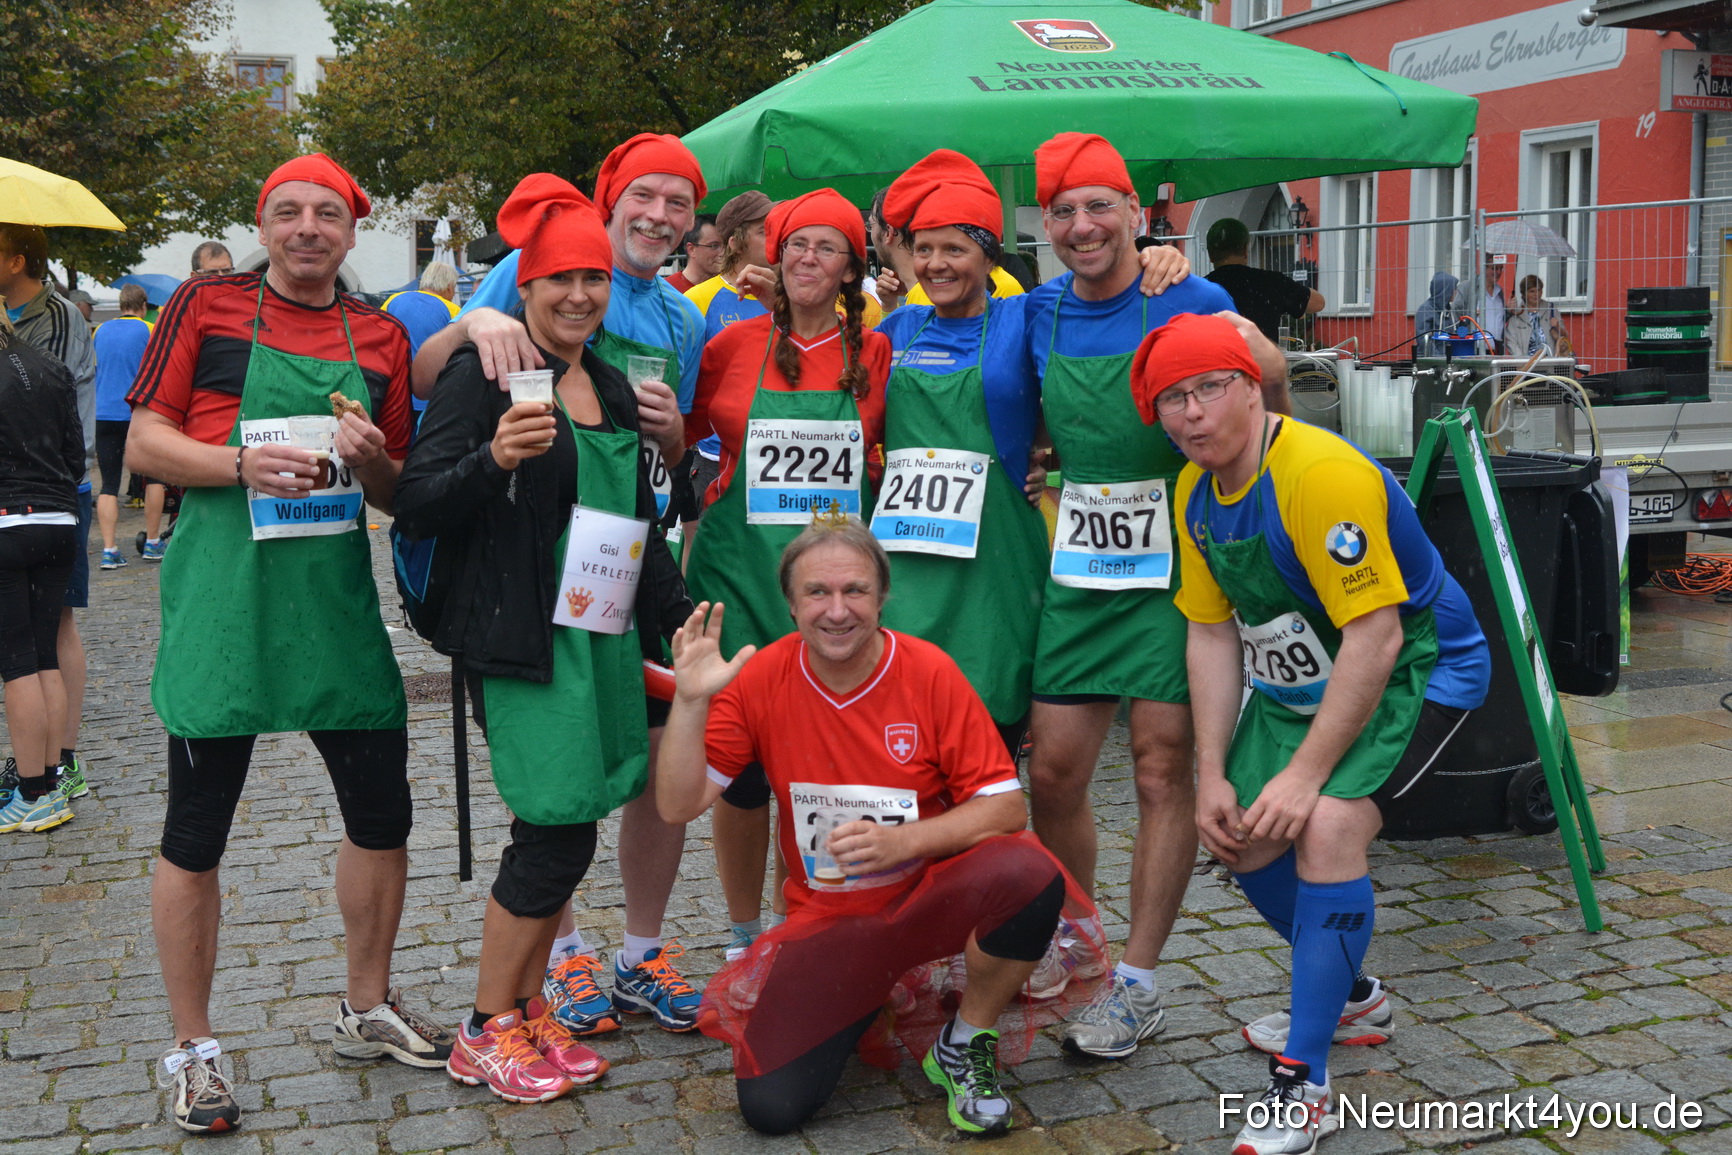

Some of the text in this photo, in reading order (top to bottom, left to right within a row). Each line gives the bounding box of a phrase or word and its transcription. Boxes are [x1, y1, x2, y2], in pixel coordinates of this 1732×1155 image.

[1400, 22, 1612, 81] Gasthaus Ehrnsberger
[996, 59, 1203, 74] Neumarkter
[967, 72, 1266, 92] Lammsbräu
[1636, 111, 1656, 138] 19
[1641, 332, 1683, 340] Lammsbräu
[245, 431, 290, 443] PARTL
[750, 429, 845, 441] PARTL Neumarkt
[759, 445, 853, 484] 2224
[888, 458, 967, 471] PARTL Neumarkt
[778, 493, 831, 512] Brigitte
[883, 474, 974, 514] 2407
[1062, 490, 1145, 506] PARTL Neumarkt
[275, 502, 346, 522] Wolfgang
[895, 521, 945, 539] Carolin
[1067, 508, 1156, 550] 2067
[600, 543, 620, 557] Gisi
[1088, 559, 1136, 575] Gisela
[1341, 566, 1378, 588] PARTL
[1345, 577, 1380, 597] Neumarkt
[1274, 688, 1314, 705] Ralph
[794, 794, 893, 809] PARTL Neumarkt
